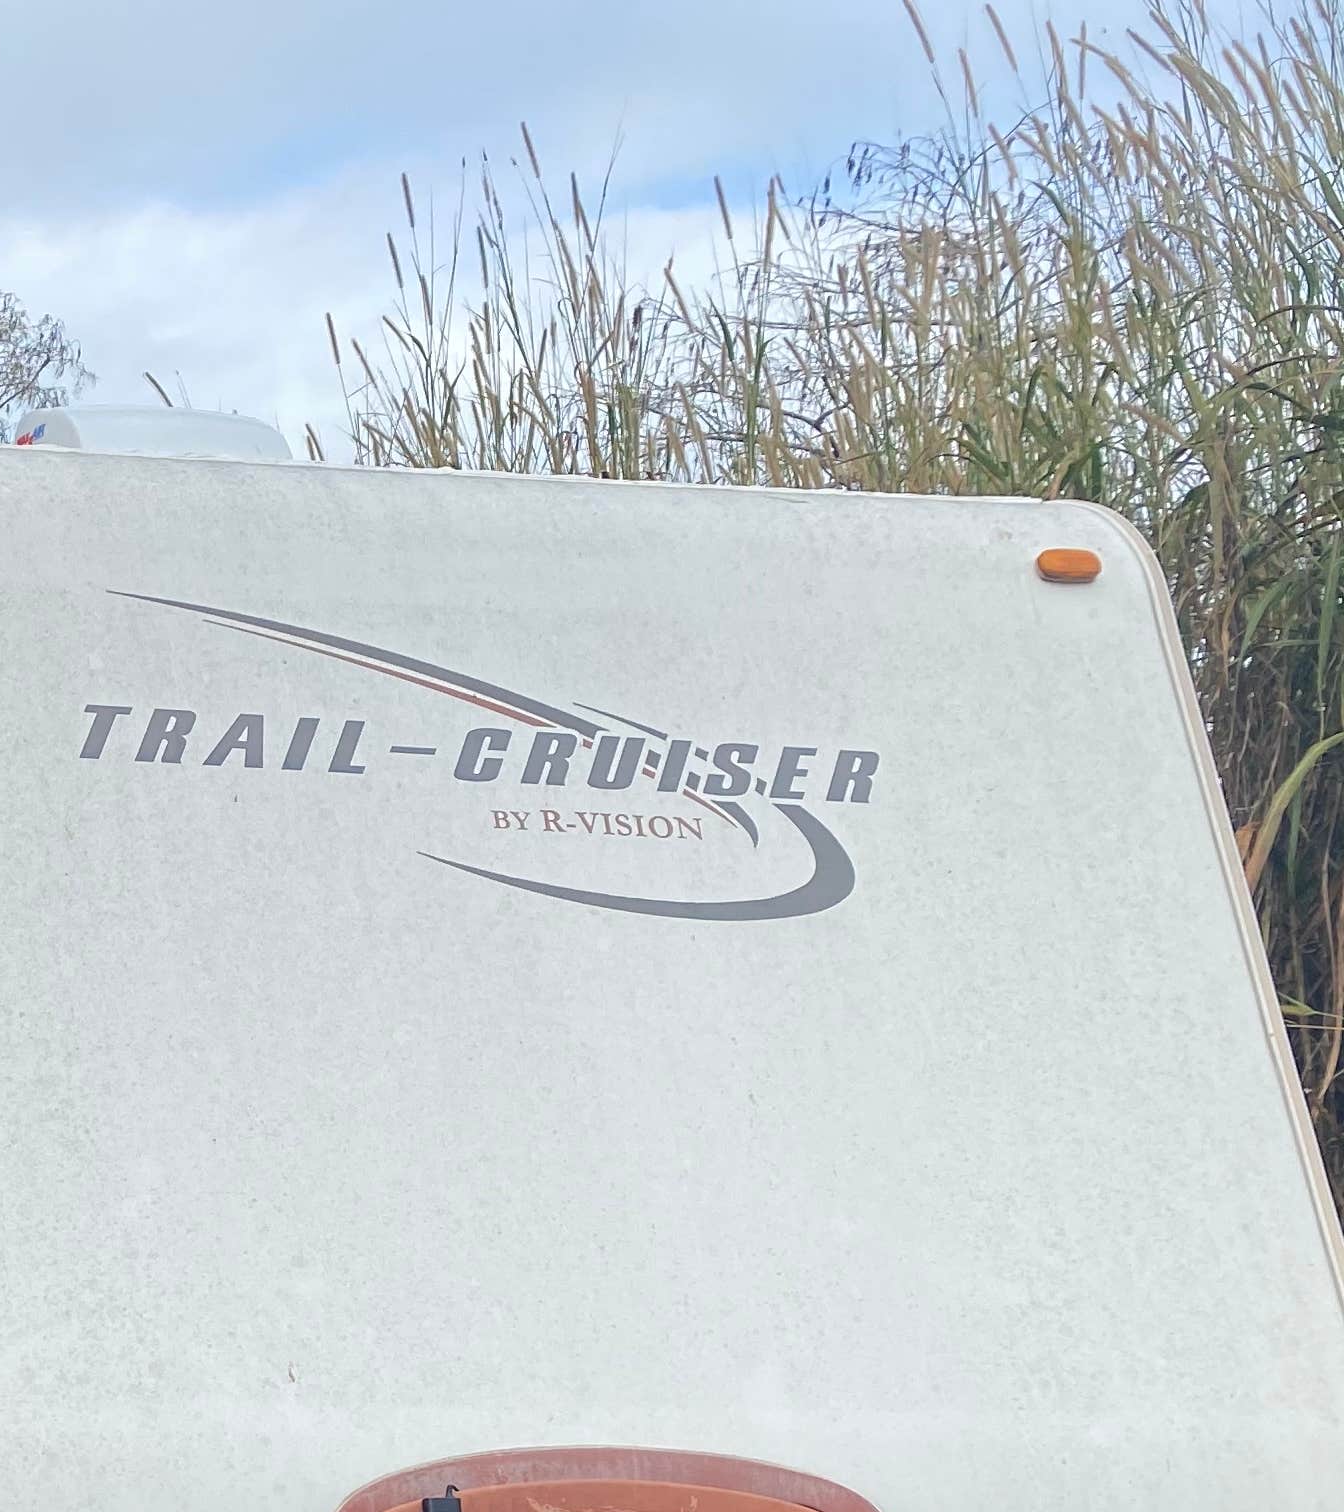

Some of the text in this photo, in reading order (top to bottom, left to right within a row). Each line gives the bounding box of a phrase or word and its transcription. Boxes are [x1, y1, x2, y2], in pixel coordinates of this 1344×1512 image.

[79, 703, 880, 804] TRAIL-CRUISER
[492, 808, 703, 840] BY R-VISION
